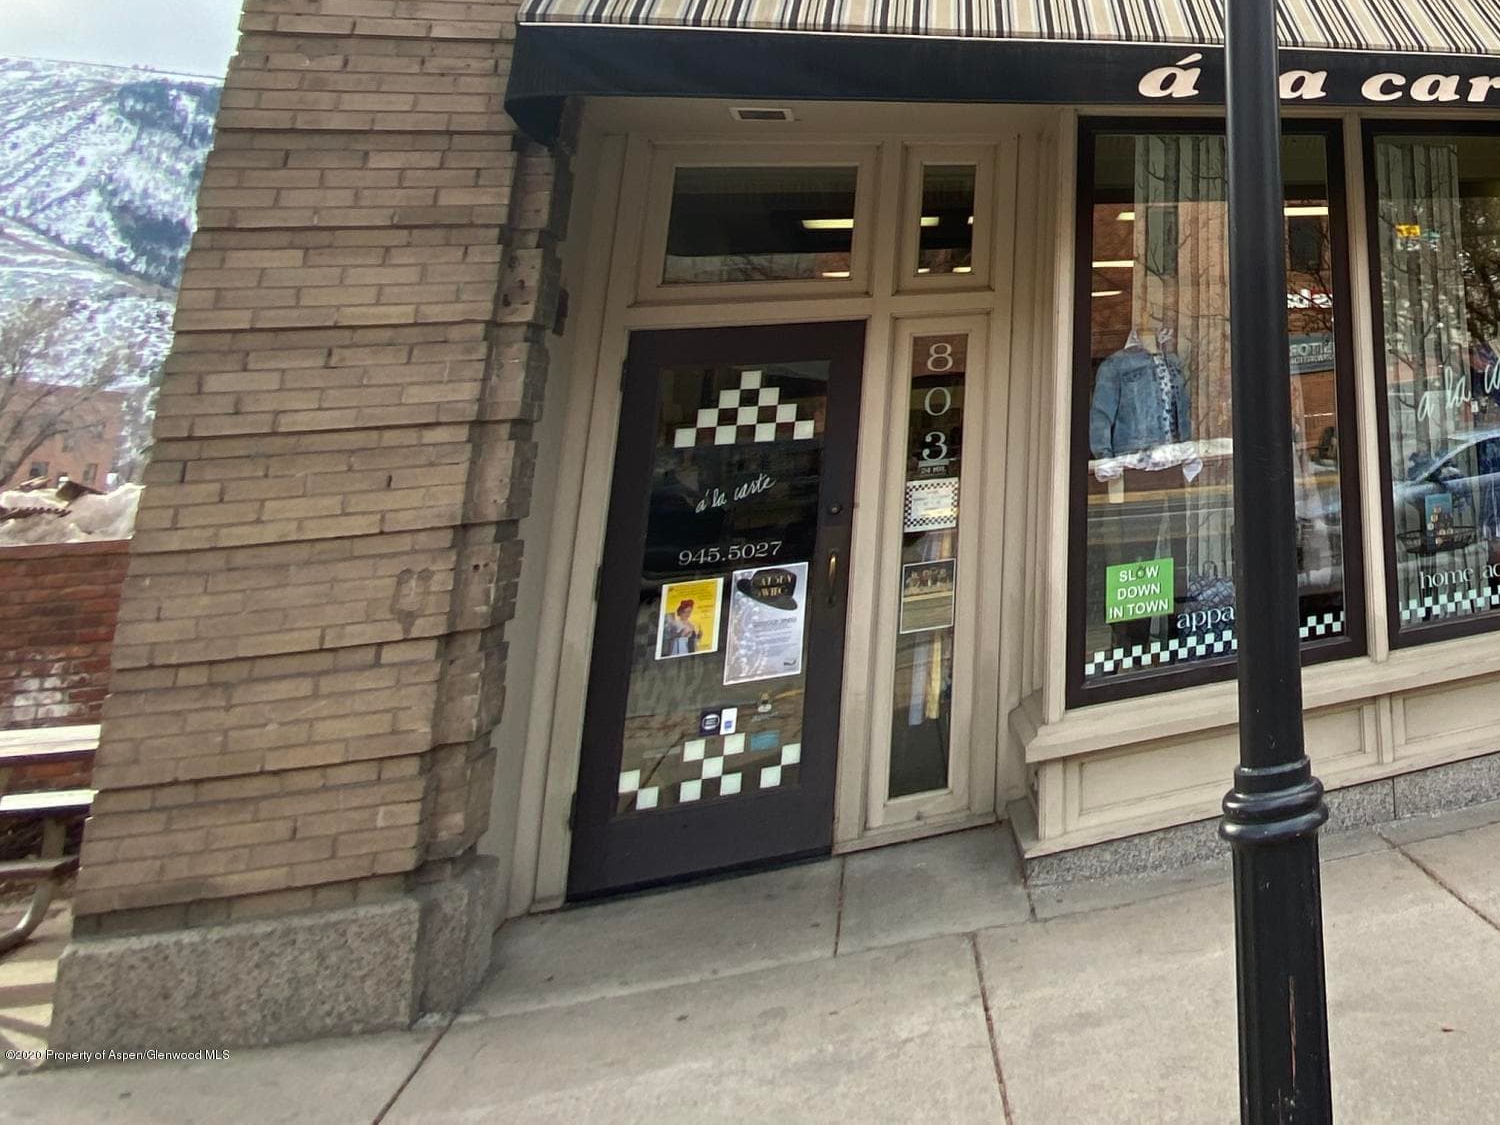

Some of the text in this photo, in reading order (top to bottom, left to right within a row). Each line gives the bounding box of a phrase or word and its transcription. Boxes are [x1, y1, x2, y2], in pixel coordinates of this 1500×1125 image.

[1138, 53, 1203, 99] á
[1279, 69, 1328, 100] a
[1444, 366, 1472, 409] la
[711, 488, 727, 508] la
[733, 473, 776, 501] carte
[678, 541, 782, 566] 945.5027
[1119, 565, 1159, 582] SLW
[1420, 568, 1474, 590] home
[1117, 582, 1161, 600] DOWN
[1109, 598, 1169, 619] IN TOWN
[1177, 605, 1235, 631] appa
